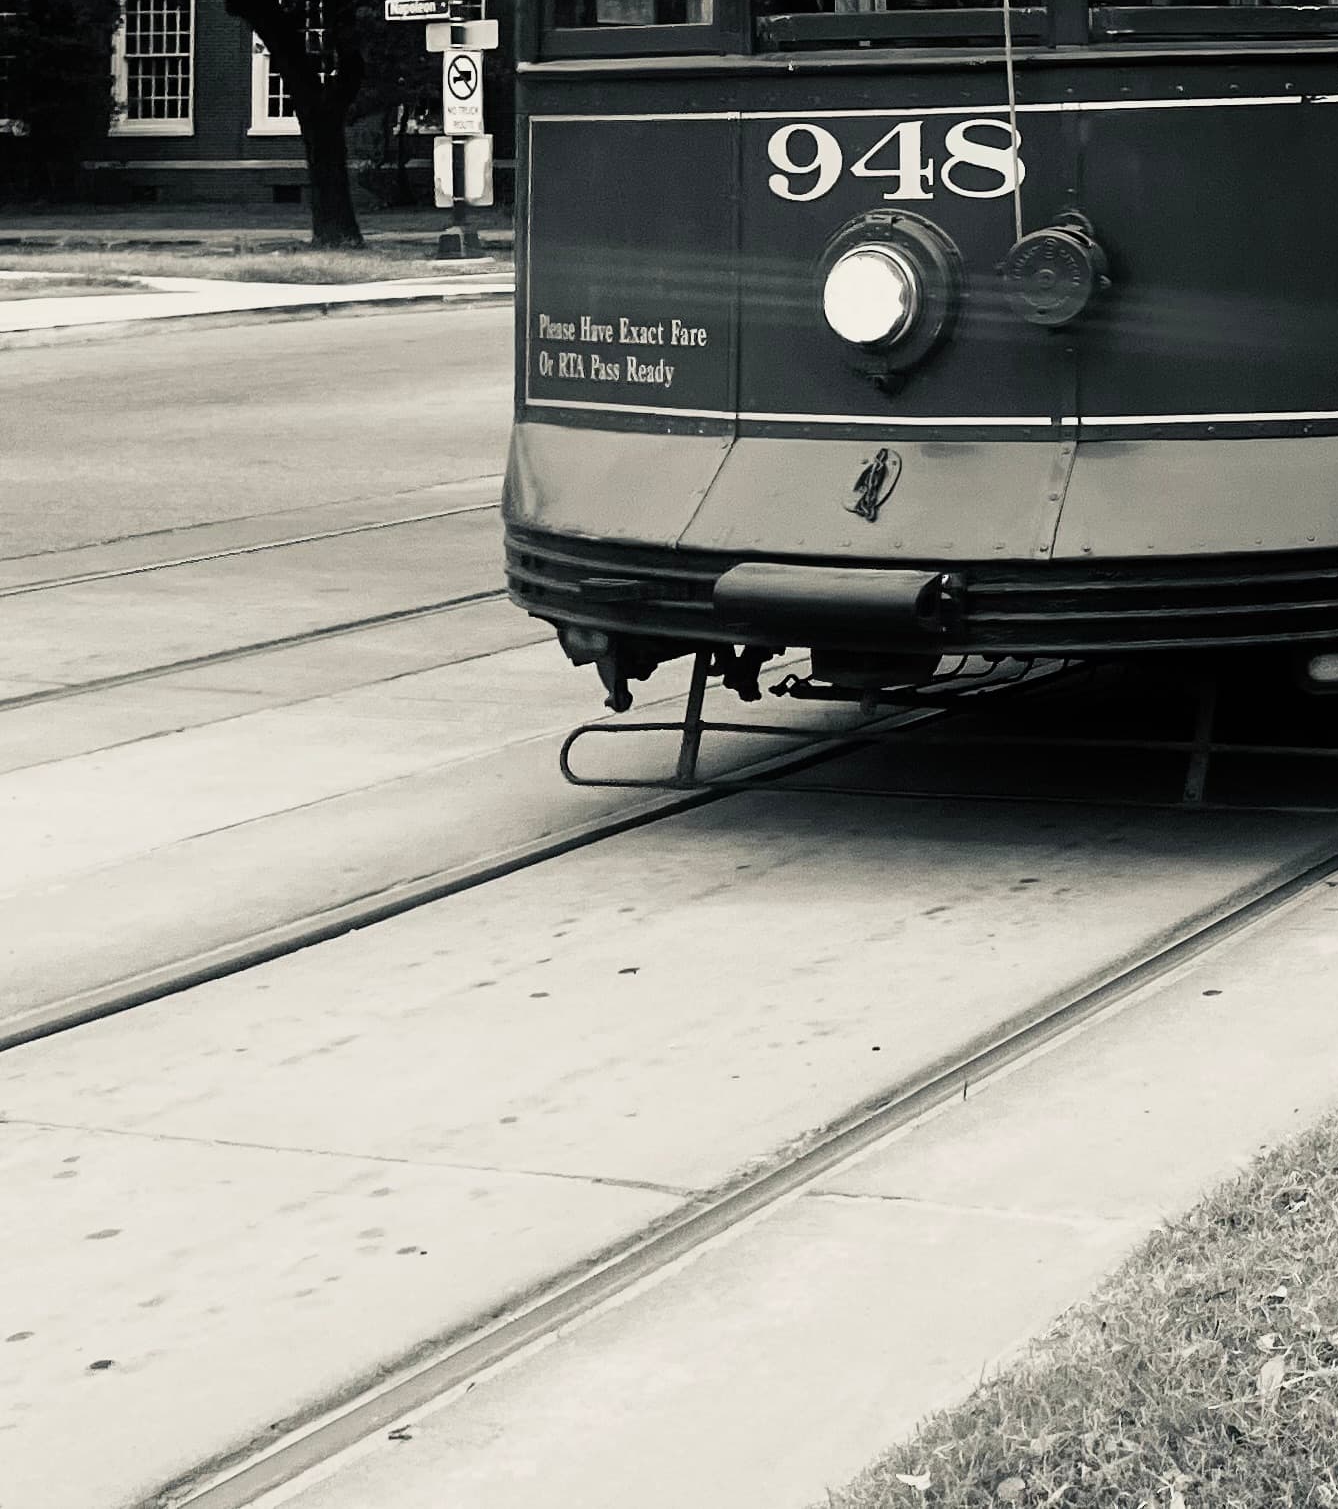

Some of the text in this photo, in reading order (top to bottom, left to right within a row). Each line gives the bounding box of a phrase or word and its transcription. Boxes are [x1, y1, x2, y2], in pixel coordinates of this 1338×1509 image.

[390, 2, 436, 16] Napoleon
[767, 118, 1026, 201] 948
[539, 313, 708, 347] Please Have Exact Fare
[539, 350, 675, 387] Or RTA Pass Ready
